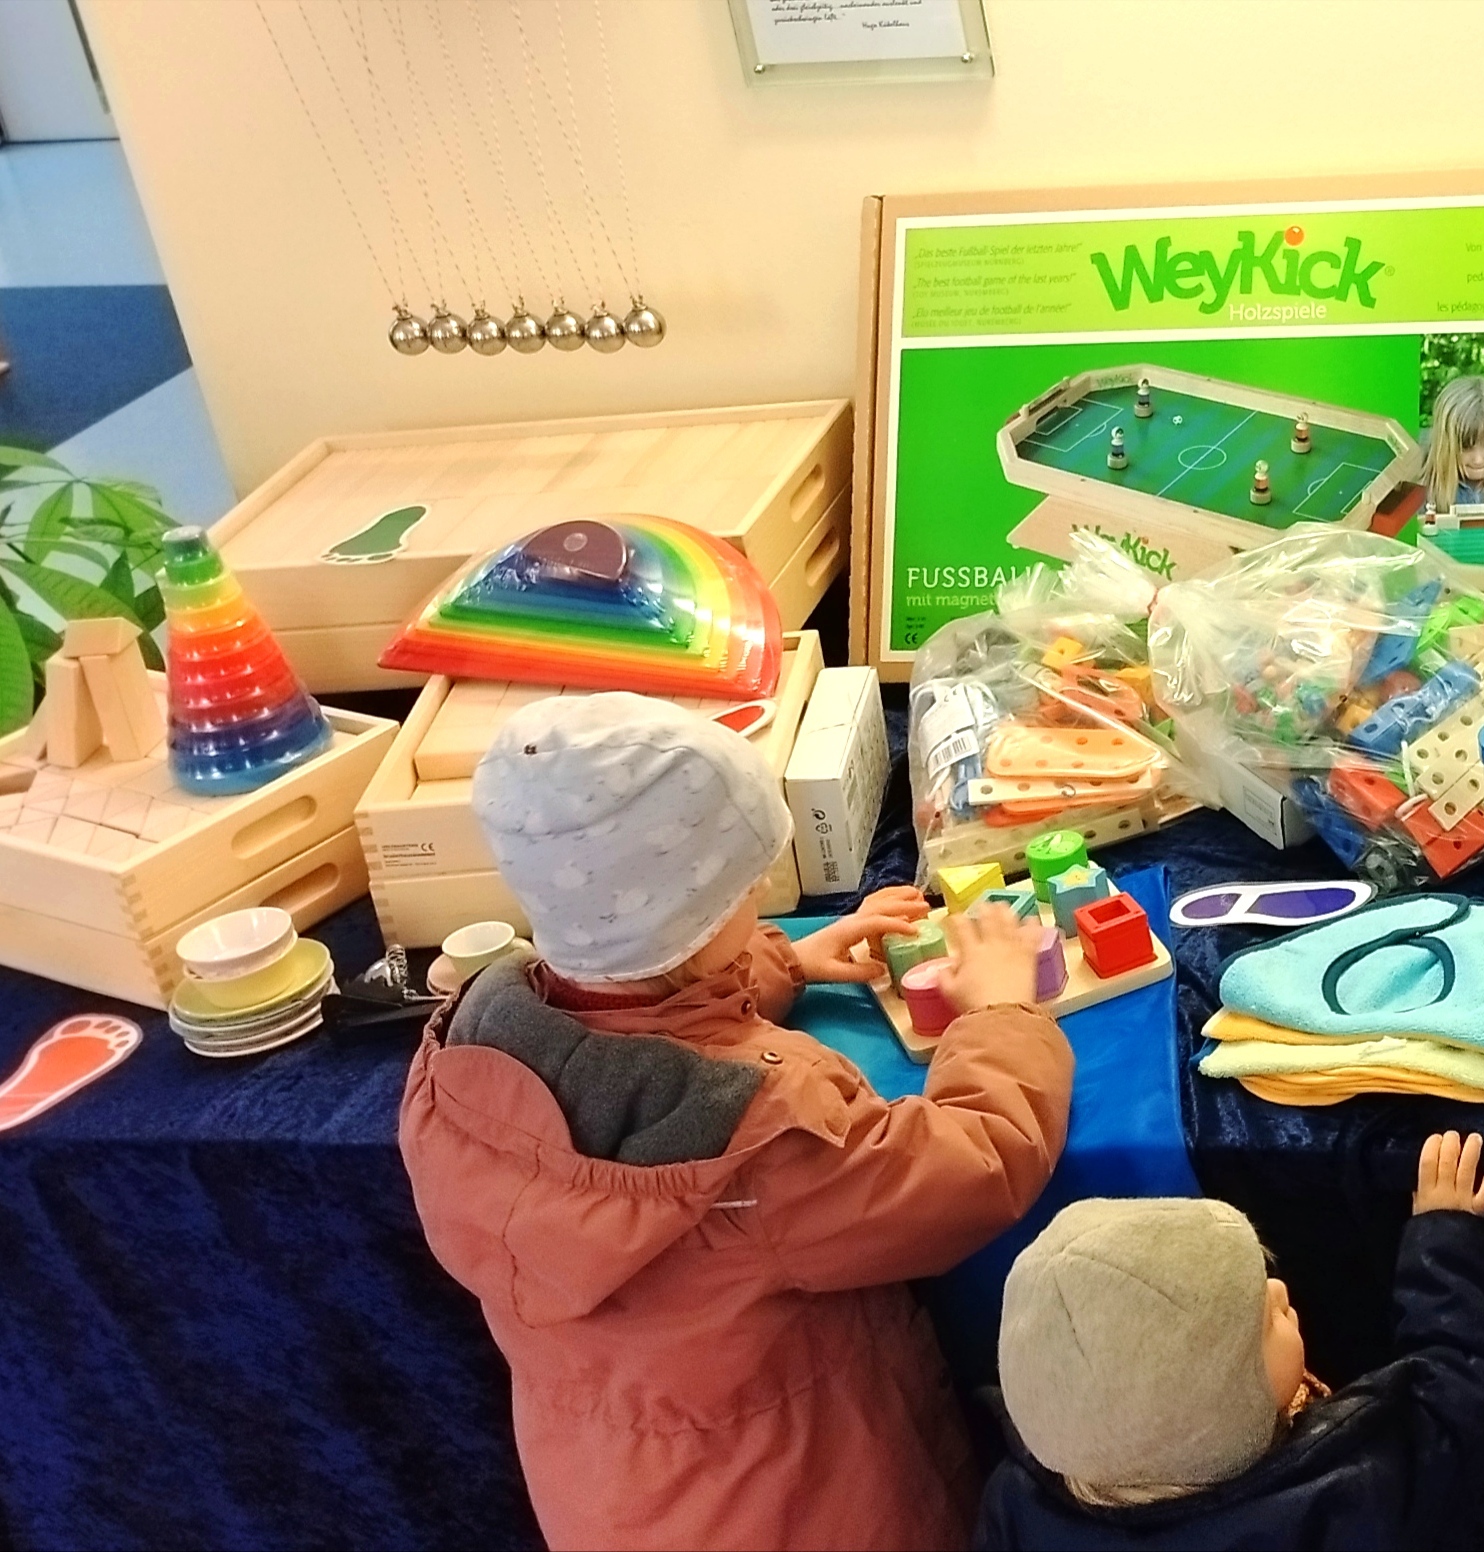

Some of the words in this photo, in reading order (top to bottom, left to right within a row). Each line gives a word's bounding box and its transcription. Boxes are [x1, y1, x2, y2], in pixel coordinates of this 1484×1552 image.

[1012, 245, 1026, 255] der
[1465, 243, 1482, 252] Von
[1091, 226, 1386, 315] WeyKick
[933, 277, 949, 287] best
[951, 275, 982, 287] football
[983, 277, 1005, 288] game
[1007, 274, 1017, 283] of
[1018, 274, 1031, 283] the
[1033, 273, 1048, 283] last
[979, 304, 990, 316] de
[991, 303, 1022, 315] football
[1023, 303, 1034, 314] de
[1229, 301, 1328, 323] Holzspiele
[1437, 302, 1449, 312] les
[906, 594, 932, 607] mit
[936, 594, 996, 609] magnet
